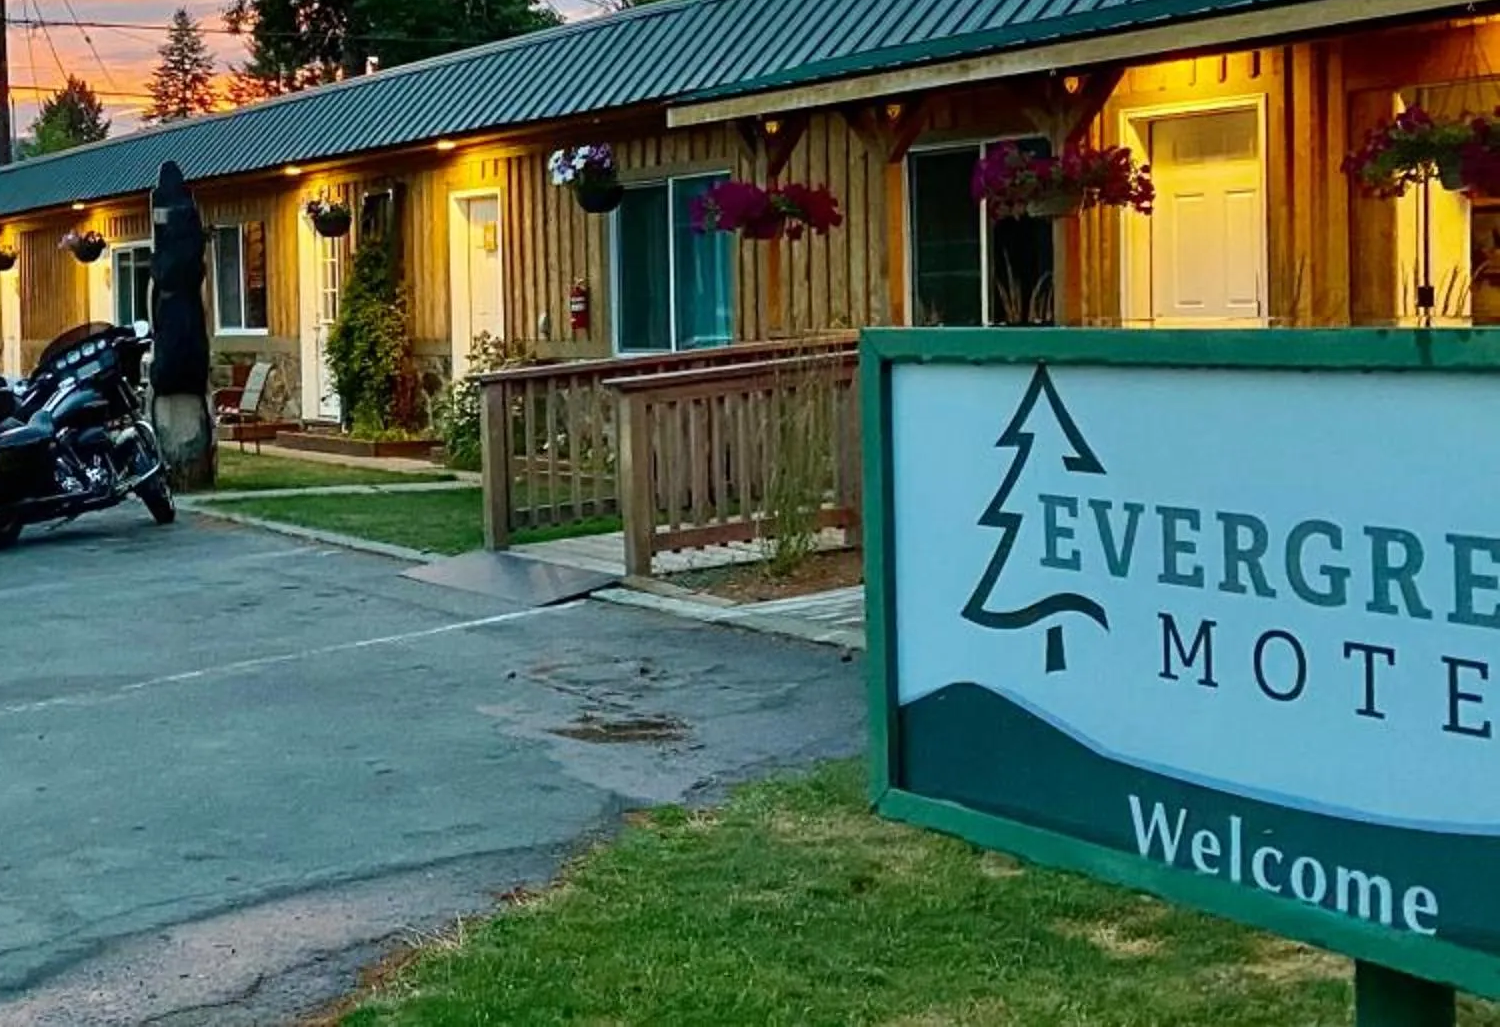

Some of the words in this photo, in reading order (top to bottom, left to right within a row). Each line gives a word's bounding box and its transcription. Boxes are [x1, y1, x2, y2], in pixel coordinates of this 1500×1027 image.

[1038, 494, 1500, 630] EVERGRE
[1158, 613, 1492, 739] MOTE
[1128, 794, 1439, 935] Welcome
